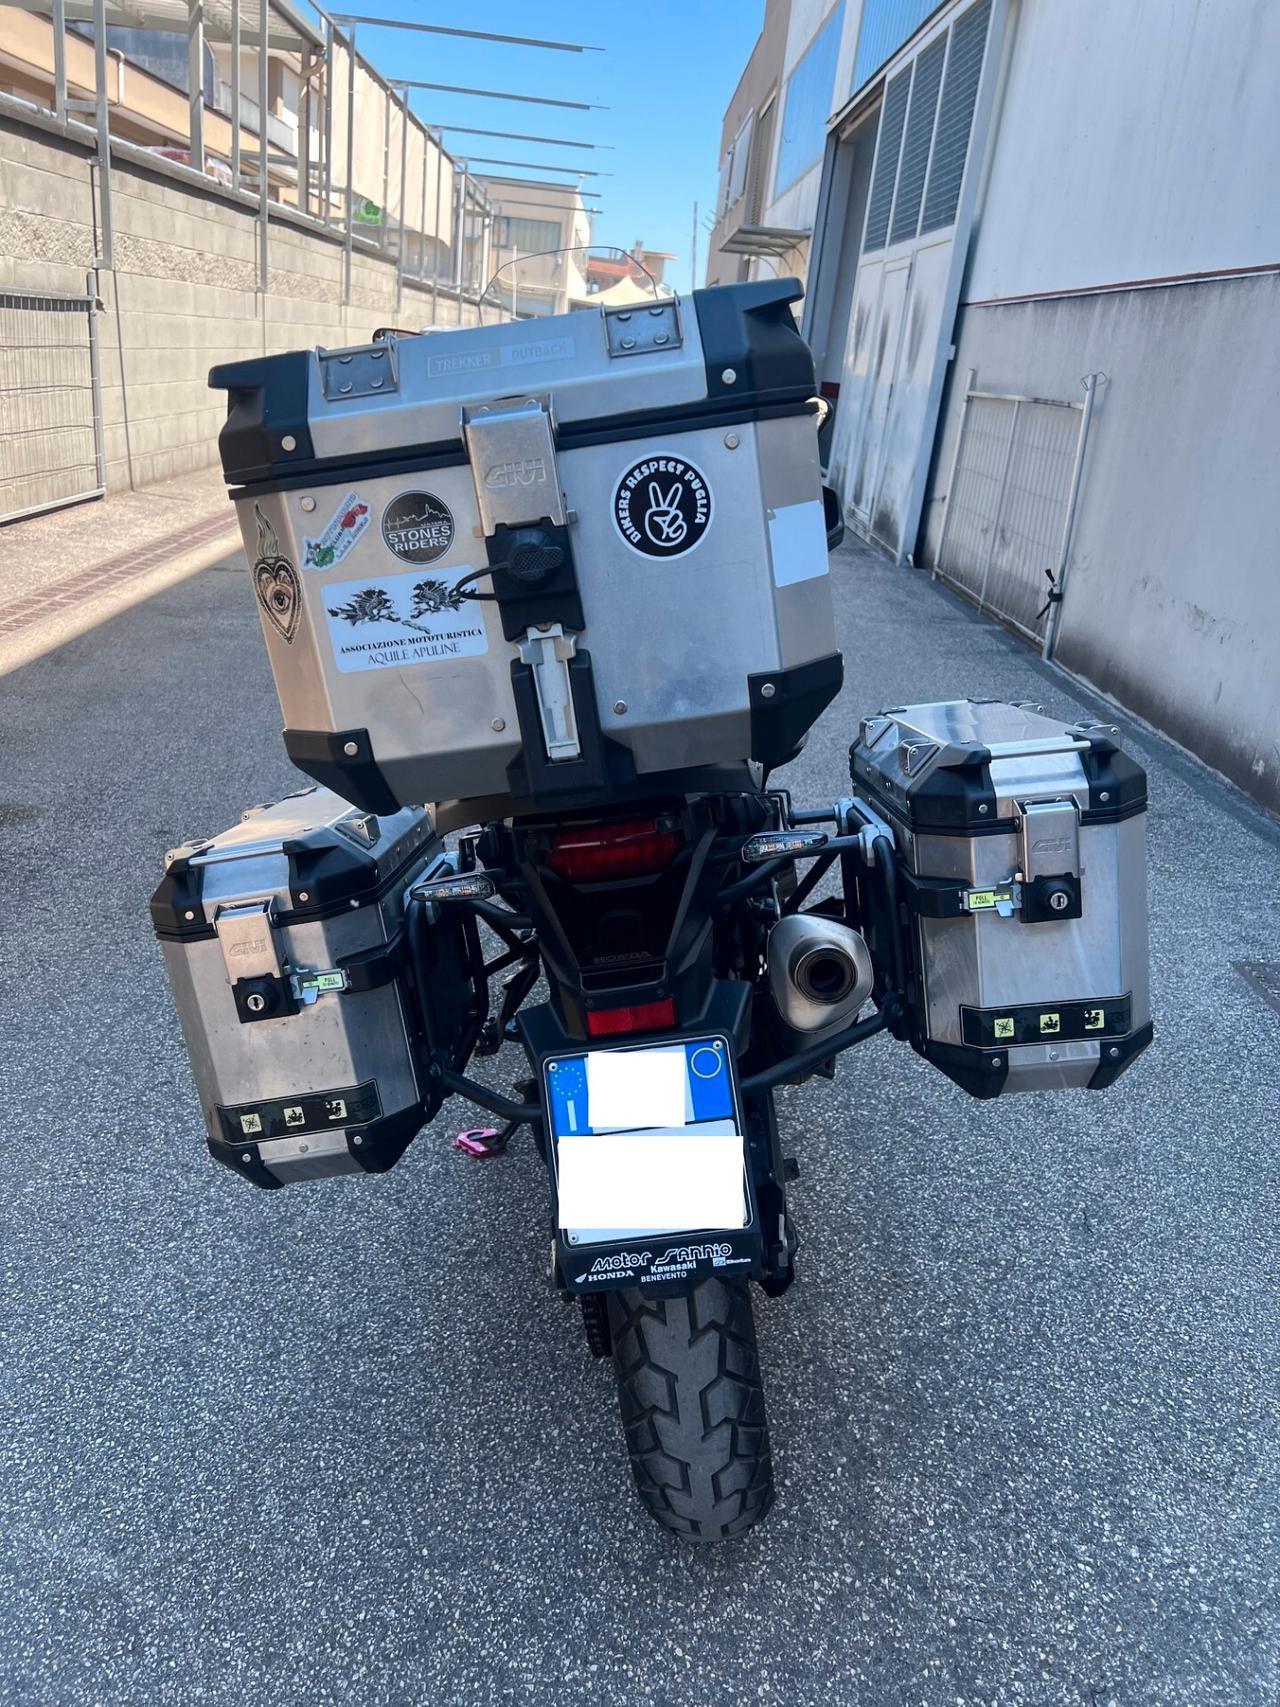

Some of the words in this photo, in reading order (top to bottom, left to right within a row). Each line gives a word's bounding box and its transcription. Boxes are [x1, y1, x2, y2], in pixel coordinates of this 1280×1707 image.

[436, 353, 491, 372] TREKKER
[511, 344, 567, 361] OUTBACK
[484, 458, 546, 488] GIVI
[625, 460, 685, 488] RESPECT
[684, 470, 708, 524] PUGLIA
[618, 489, 642, 543] BIKERS
[388, 525, 451, 544] STONES
[394, 536, 449, 552] RIDERS
[340, 638, 407, 655] ASSOCIAZIONE
[407, 628, 483, 645] MOTOTURISTICA
[367, 650, 411, 665] AQUILE
[412, 642, 462, 659] APULINE
[229, 939, 267, 957] GIVI
[593, 951, 652, 964] HONDA
[587, 1270, 634, 1282] HONDA
[640, 1271, 687, 1283] BENEVENTO
[650, 1260, 697, 1274] Kawasaki
